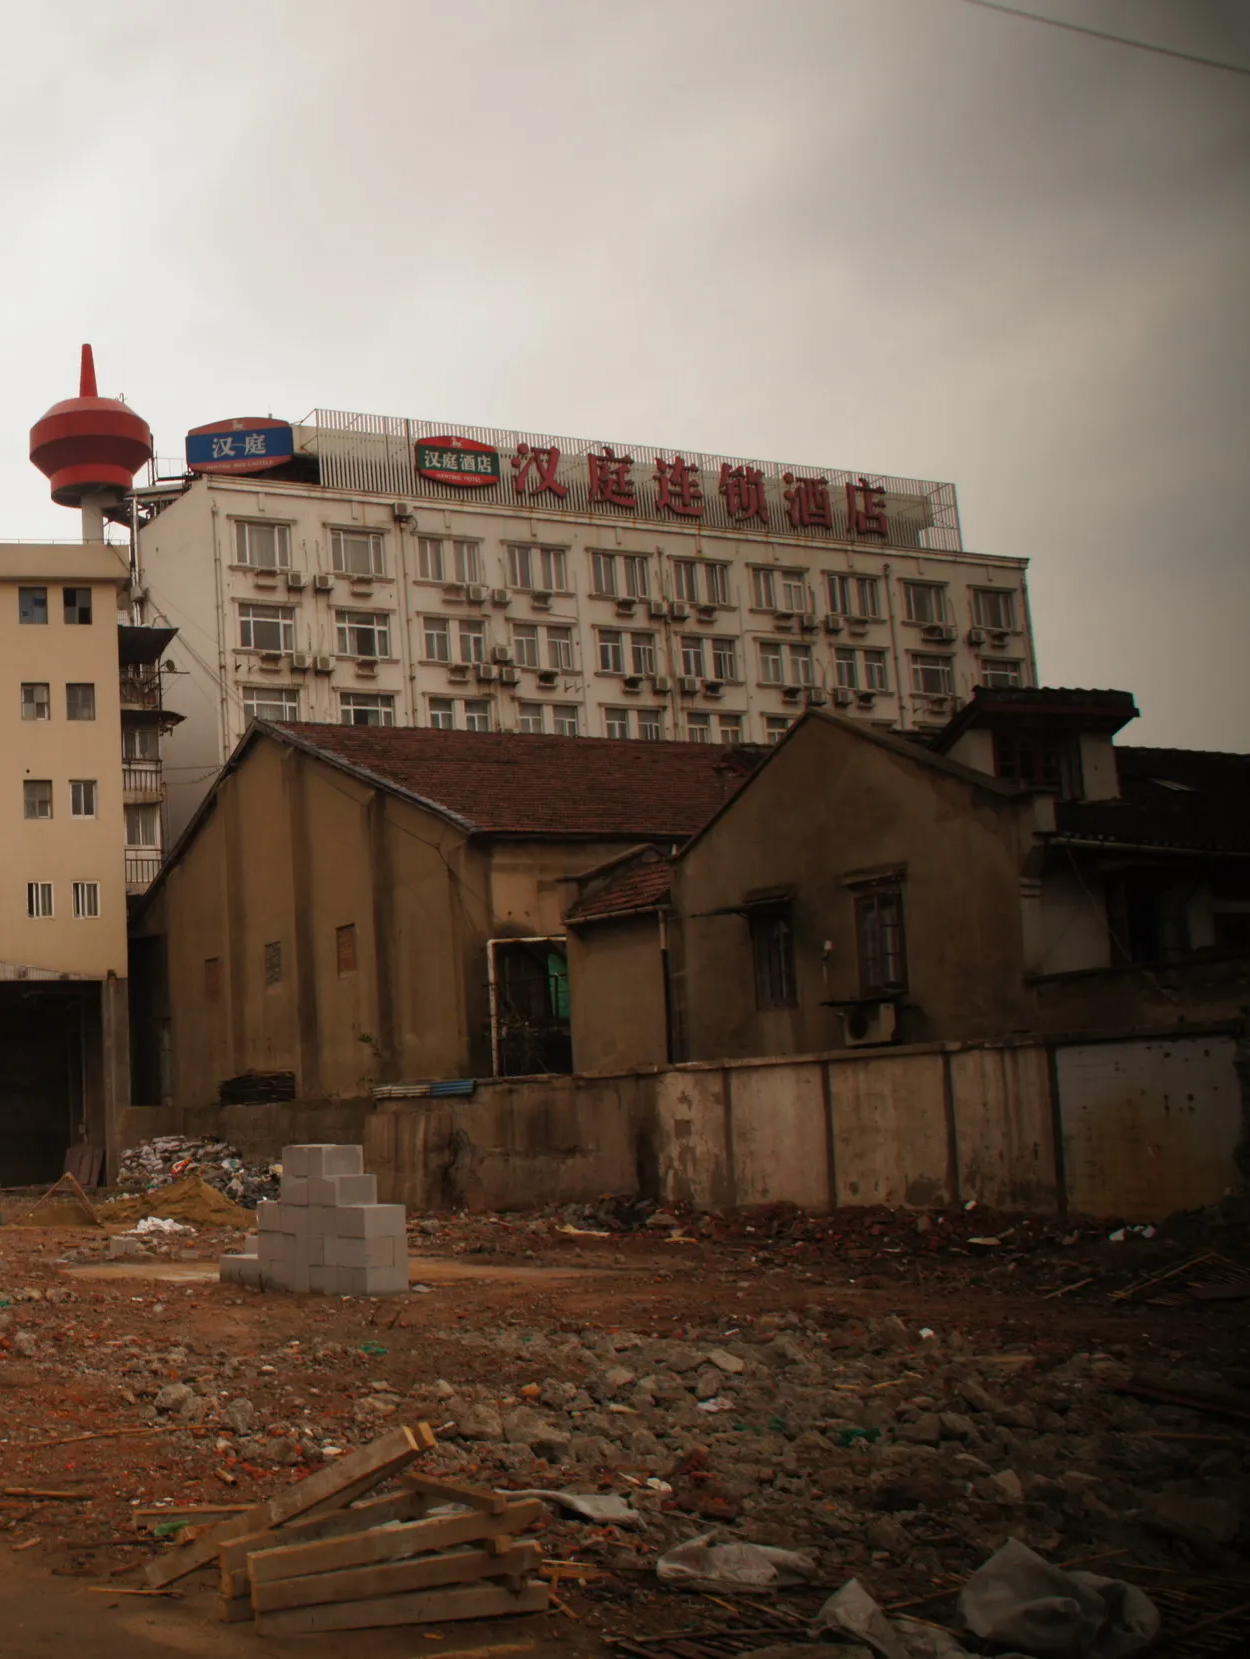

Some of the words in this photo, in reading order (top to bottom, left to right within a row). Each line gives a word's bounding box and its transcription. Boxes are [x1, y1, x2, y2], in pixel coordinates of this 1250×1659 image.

[212, 433, 266, 458] 汉庭
[425, 450, 492, 473] 汉庭酒店
[511, 443, 888, 536] 汉庭连锁酒店
